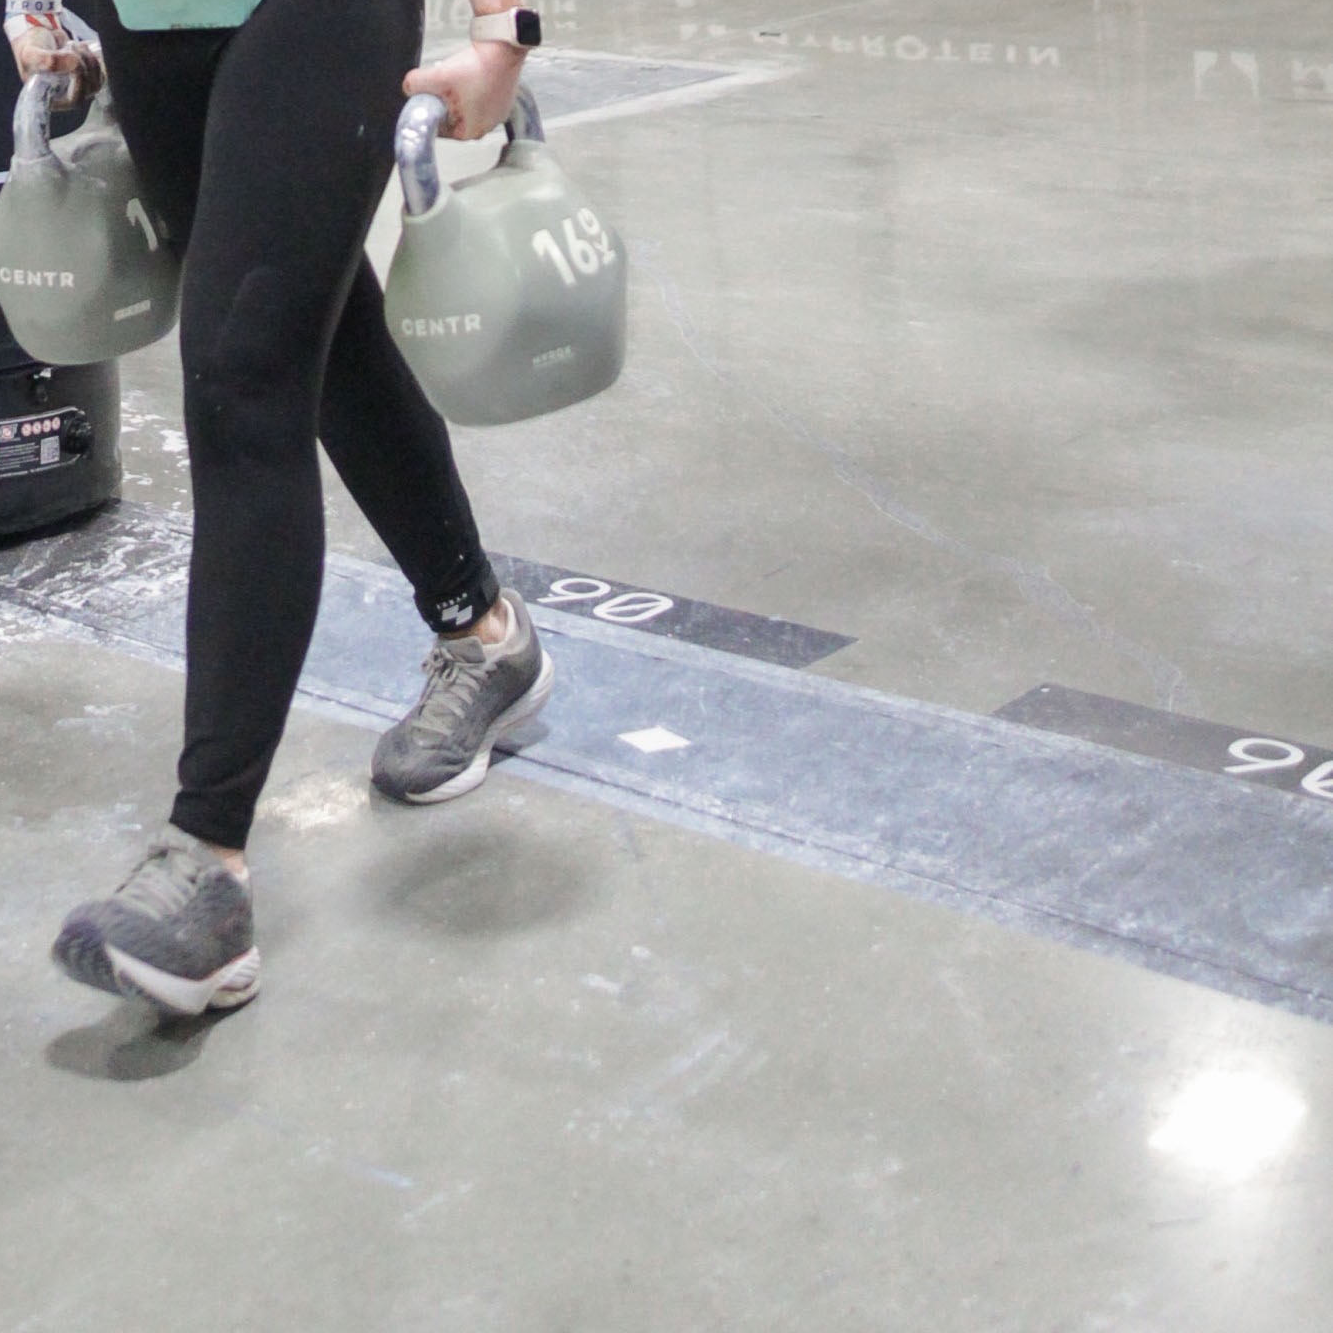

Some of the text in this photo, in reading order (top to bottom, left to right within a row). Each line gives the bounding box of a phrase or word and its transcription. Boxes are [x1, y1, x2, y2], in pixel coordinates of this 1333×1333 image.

[531, 217, 599, 285] 16
[0, 266, 75, 288] CENTR
[401, 312, 482, 335] CENTR
